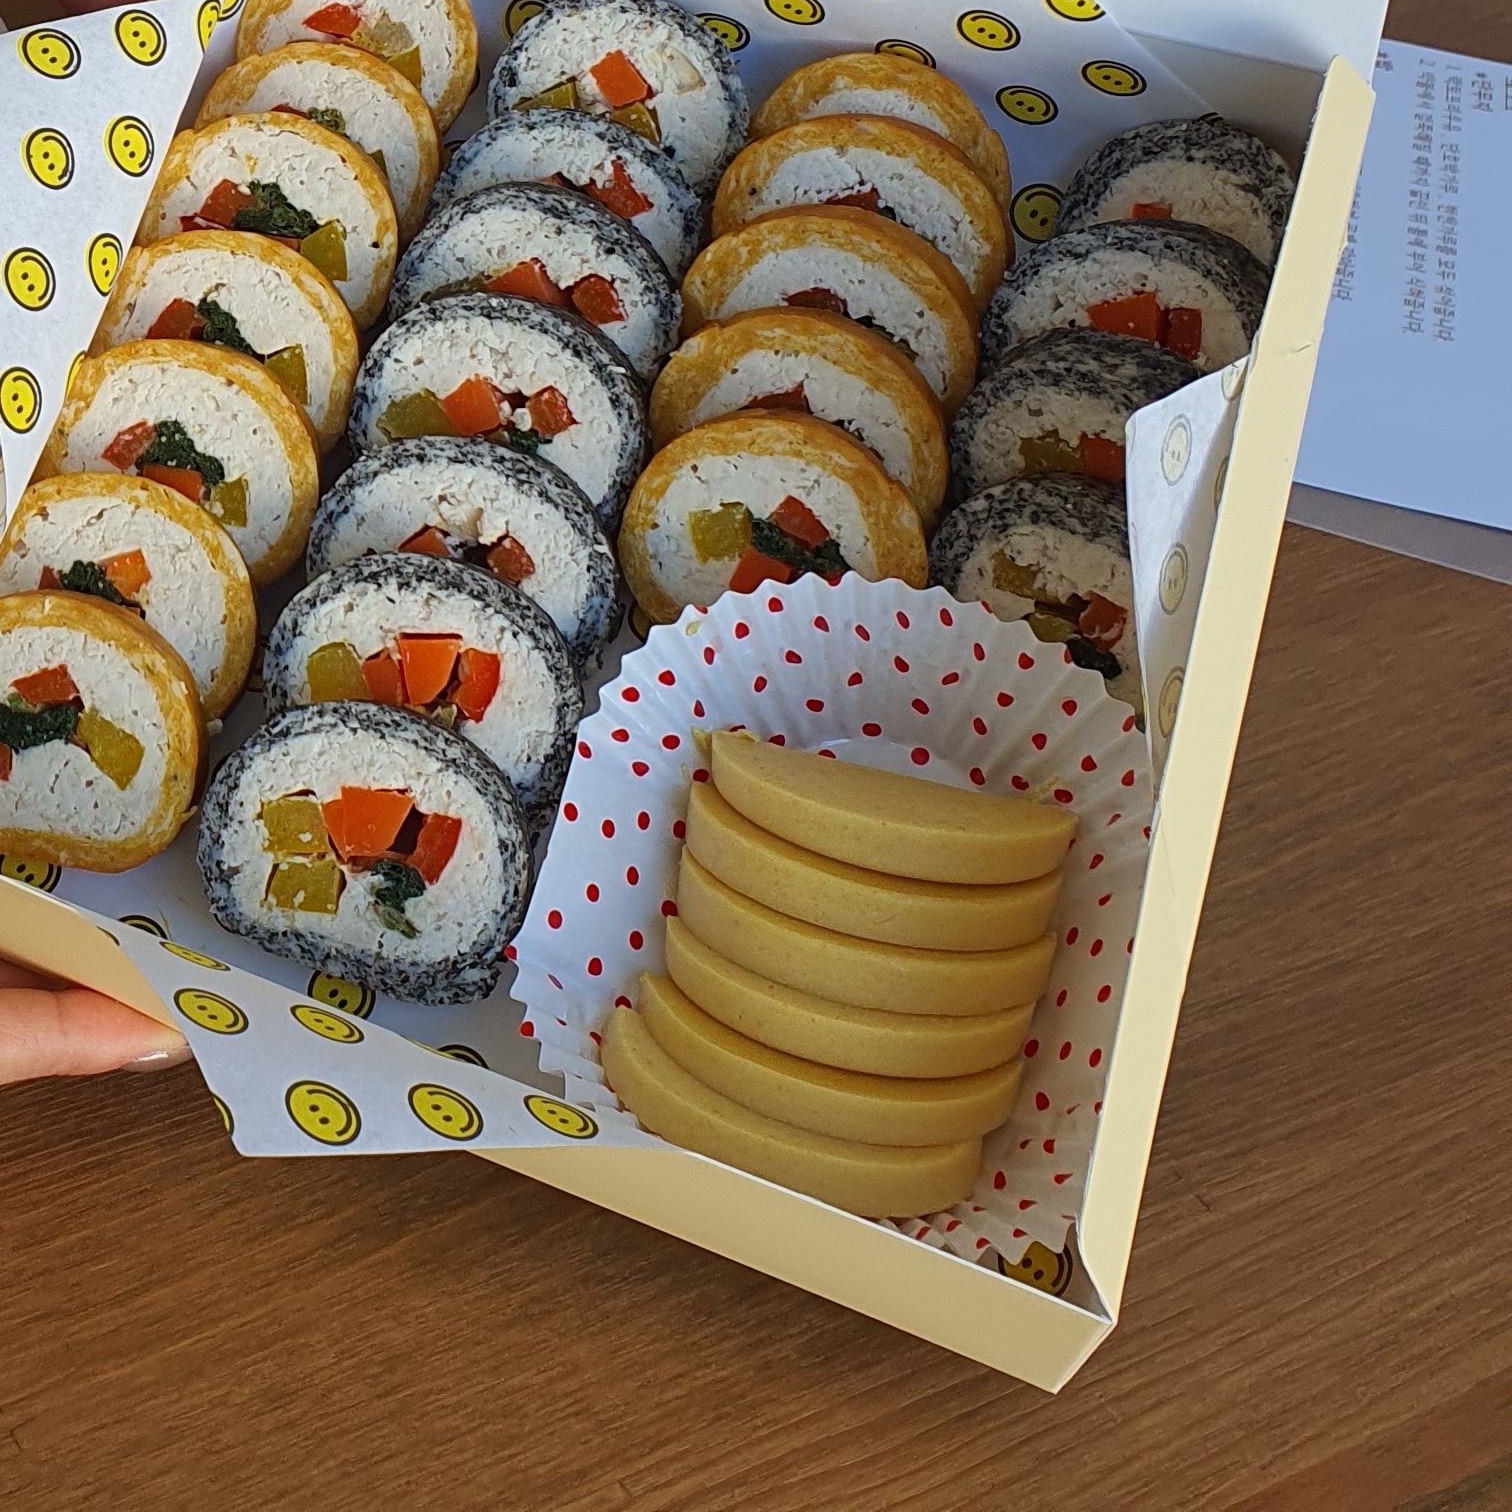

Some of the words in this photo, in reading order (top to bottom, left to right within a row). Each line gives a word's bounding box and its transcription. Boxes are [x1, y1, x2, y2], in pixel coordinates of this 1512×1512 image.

[1407, 213, 1428, 225] 뒤
[1405, 251, 1426, 274] 부어
[1434, 257, 1457, 281] 모두
